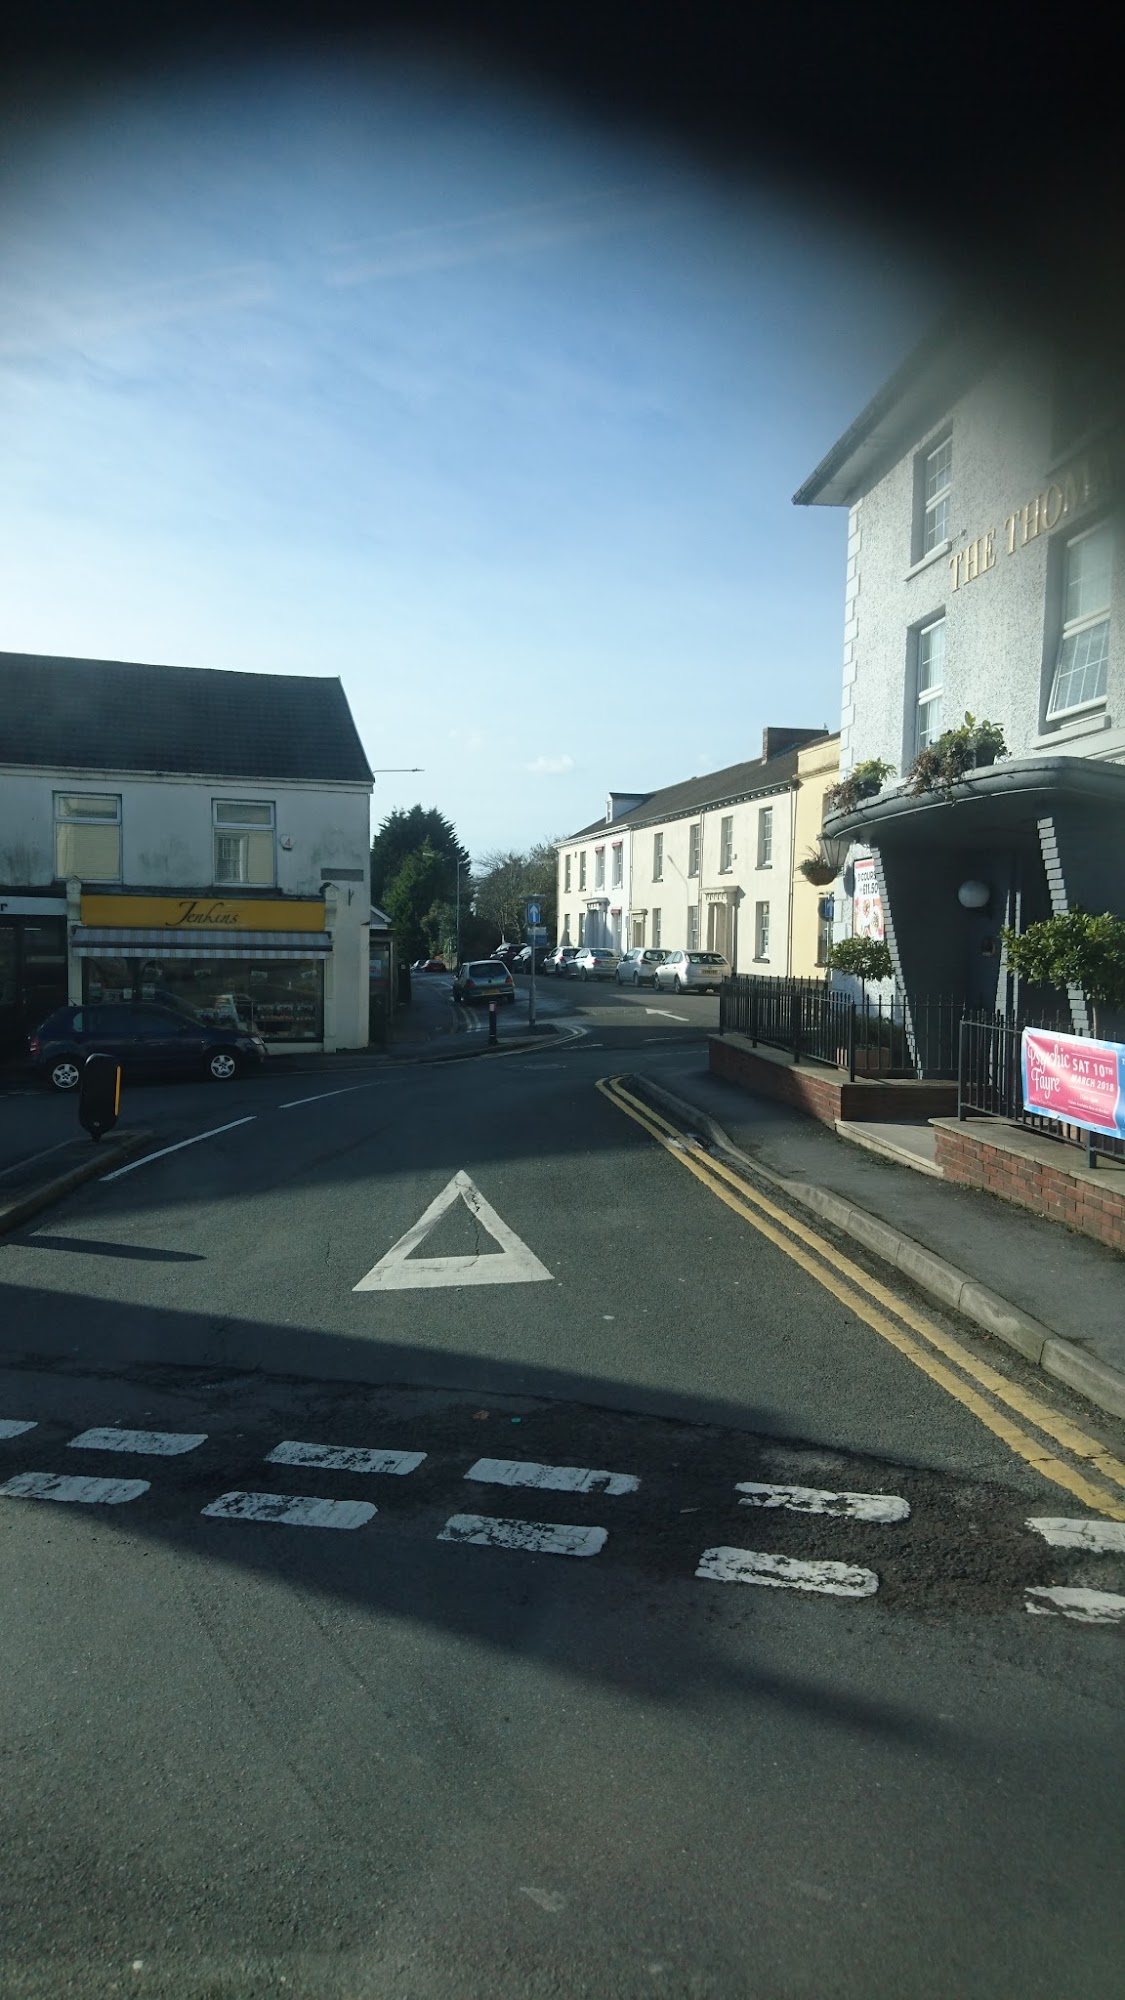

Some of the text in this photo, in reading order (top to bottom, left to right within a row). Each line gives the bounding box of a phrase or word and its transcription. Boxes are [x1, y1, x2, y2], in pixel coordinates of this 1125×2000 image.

[949, 528, 996, 593] THE
[165, 901, 239, 926] Jenkins
[1027, 1044, 1070, 1074] Psychic
[1072, 1058, 1113, 1078] SAT 10TH
[1031, 1067, 1061, 1099] Fayre
[1071, 1074, 1115, 1093] MARCH 2018
